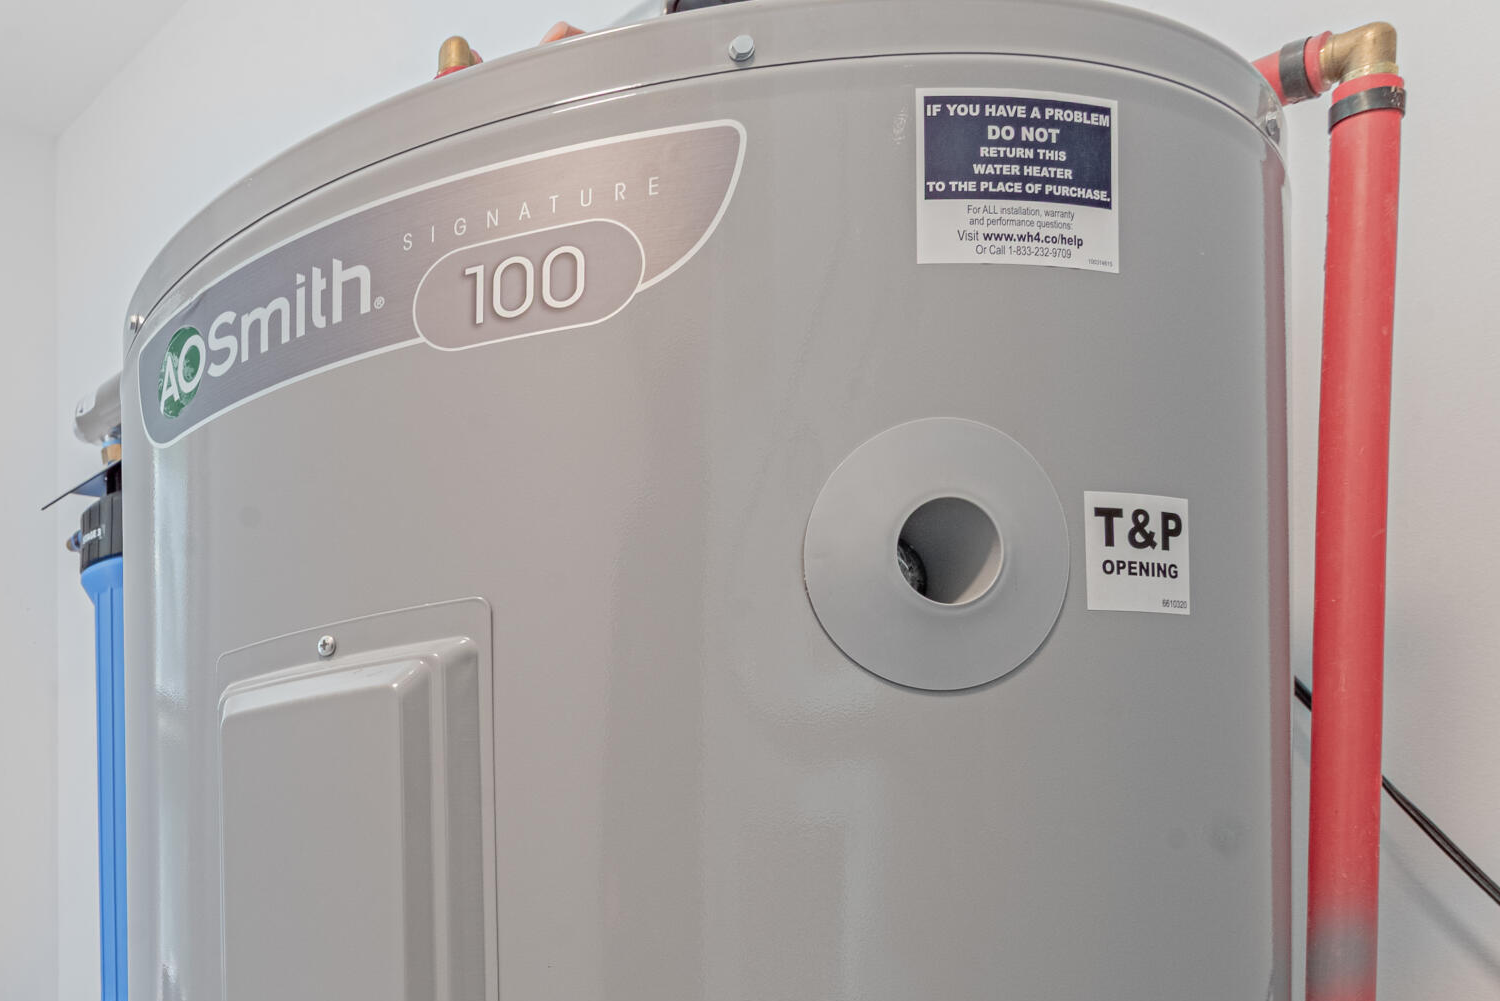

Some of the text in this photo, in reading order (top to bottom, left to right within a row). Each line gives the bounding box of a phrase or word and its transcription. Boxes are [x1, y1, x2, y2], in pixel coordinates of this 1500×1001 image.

[926, 103, 1110, 128] IF YOU HAVE A PROBLEM
[987, 125, 1060, 144] DO NOT
[980, 147, 1067, 162] RETURN THIS
[972, 164, 1073, 180] WATER HEATER
[926, 181, 1111, 202] TO THE PLACE OF PURCHASE.
[402, 176, 660, 252] SIGNATURE
[967, 204, 1075, 221] For ALL installation, warranty
[969, 216, 1073, 231] and performance questions:
[957, 229, 1084, 249] Visit www.wh4.co/help
[975, 244, 1072, 259] Or Call 1-833-232-9709
[463, 245, 586, 326] 100
[1094, 506, 1183, 551] T&P
[1102, 559, 1179, 579] OPENING
